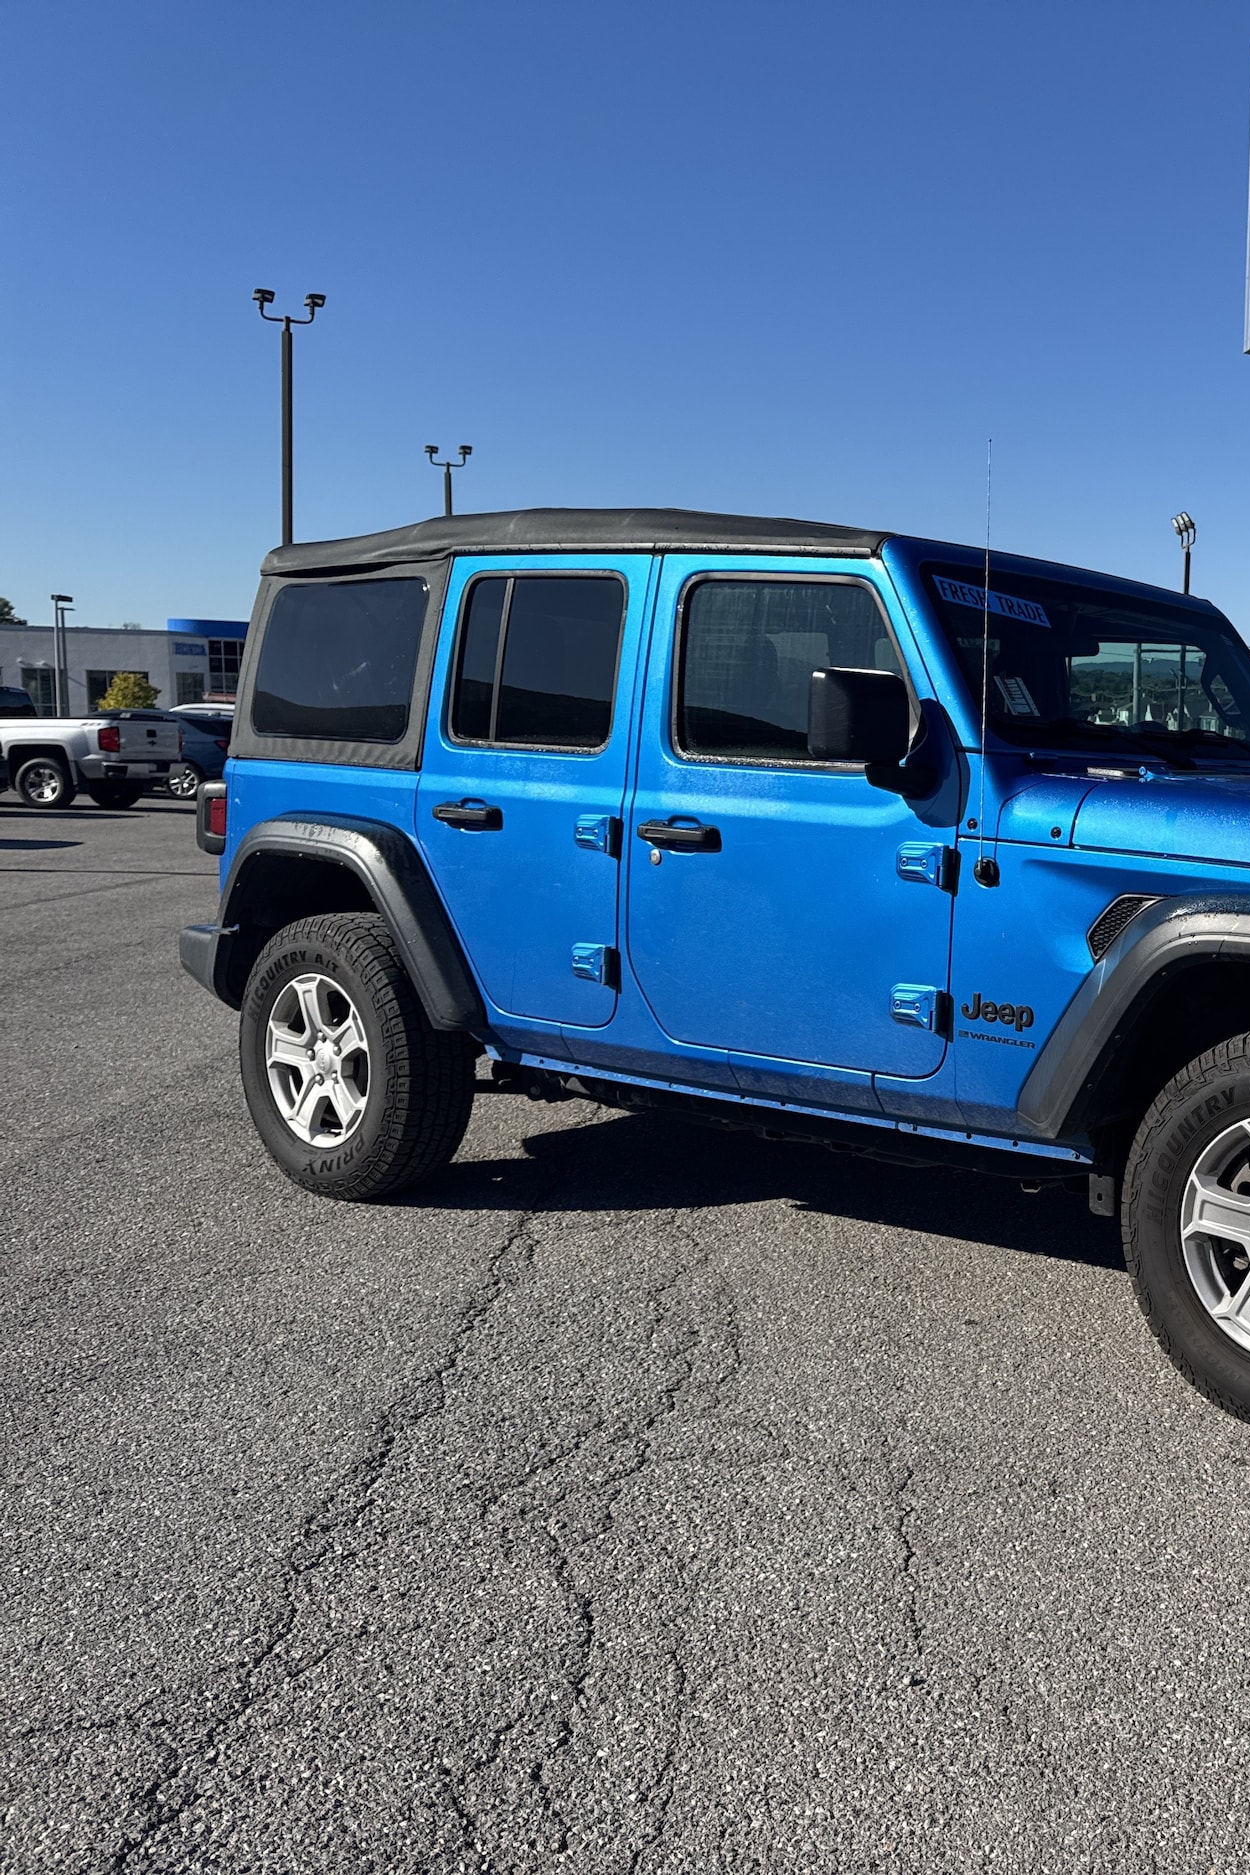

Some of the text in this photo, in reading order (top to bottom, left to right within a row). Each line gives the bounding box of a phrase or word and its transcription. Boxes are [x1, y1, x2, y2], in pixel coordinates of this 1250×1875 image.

[994, 594, 1048, 624] TRADE
[961, 992, 1034, 1032] Jeep
[969, 1031, 1035, 1049] WRANGLER
